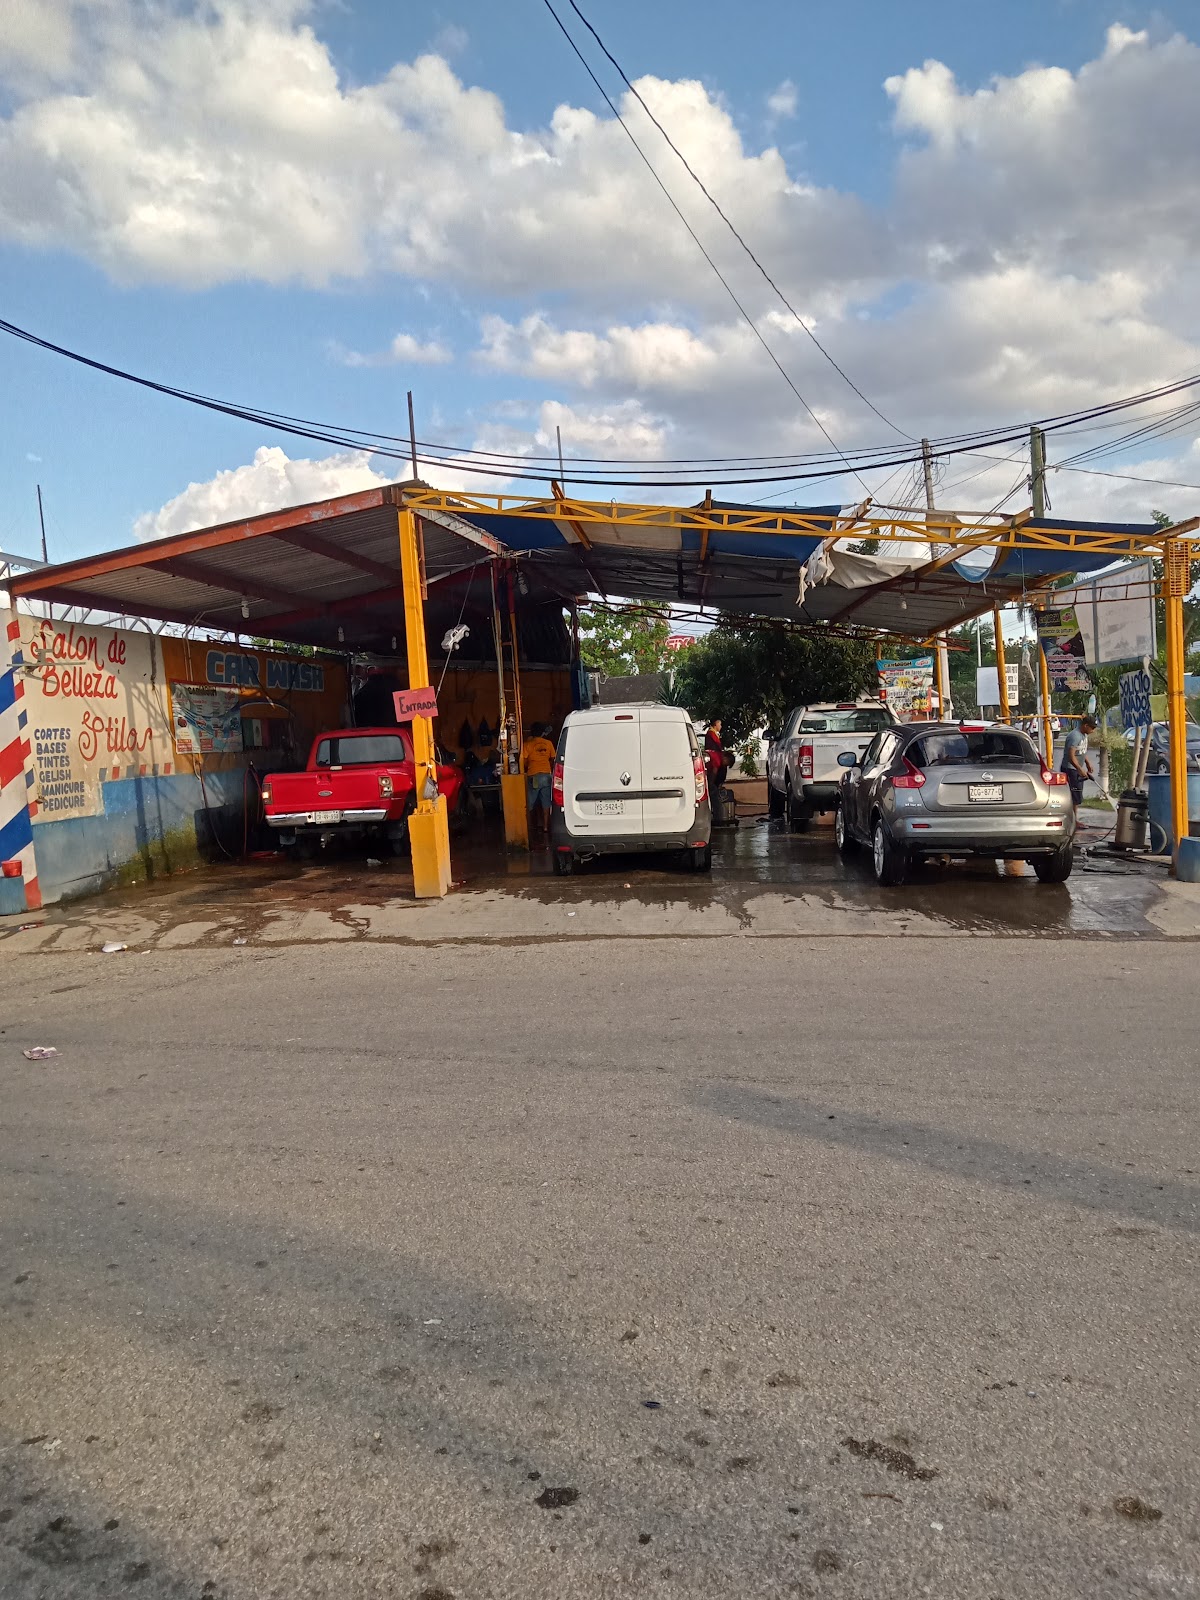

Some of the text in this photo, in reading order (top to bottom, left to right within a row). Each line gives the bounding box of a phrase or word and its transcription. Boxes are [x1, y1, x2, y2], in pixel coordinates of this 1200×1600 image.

[30, 620, 126, 671] Salon de
[39, 657, 118, 699] Belleza
[206, 650, 325, 692] CAR WASH
[34, 728, 71, 740] CORTES
[36, 742, 67, 755] BASES
[37, 756, 70, 768] TINTES
[39, 769, 72, 783] GELISH
[42, 781, 85, 797] MANICURE
[42, 795, 85, 812] PEDICURE
